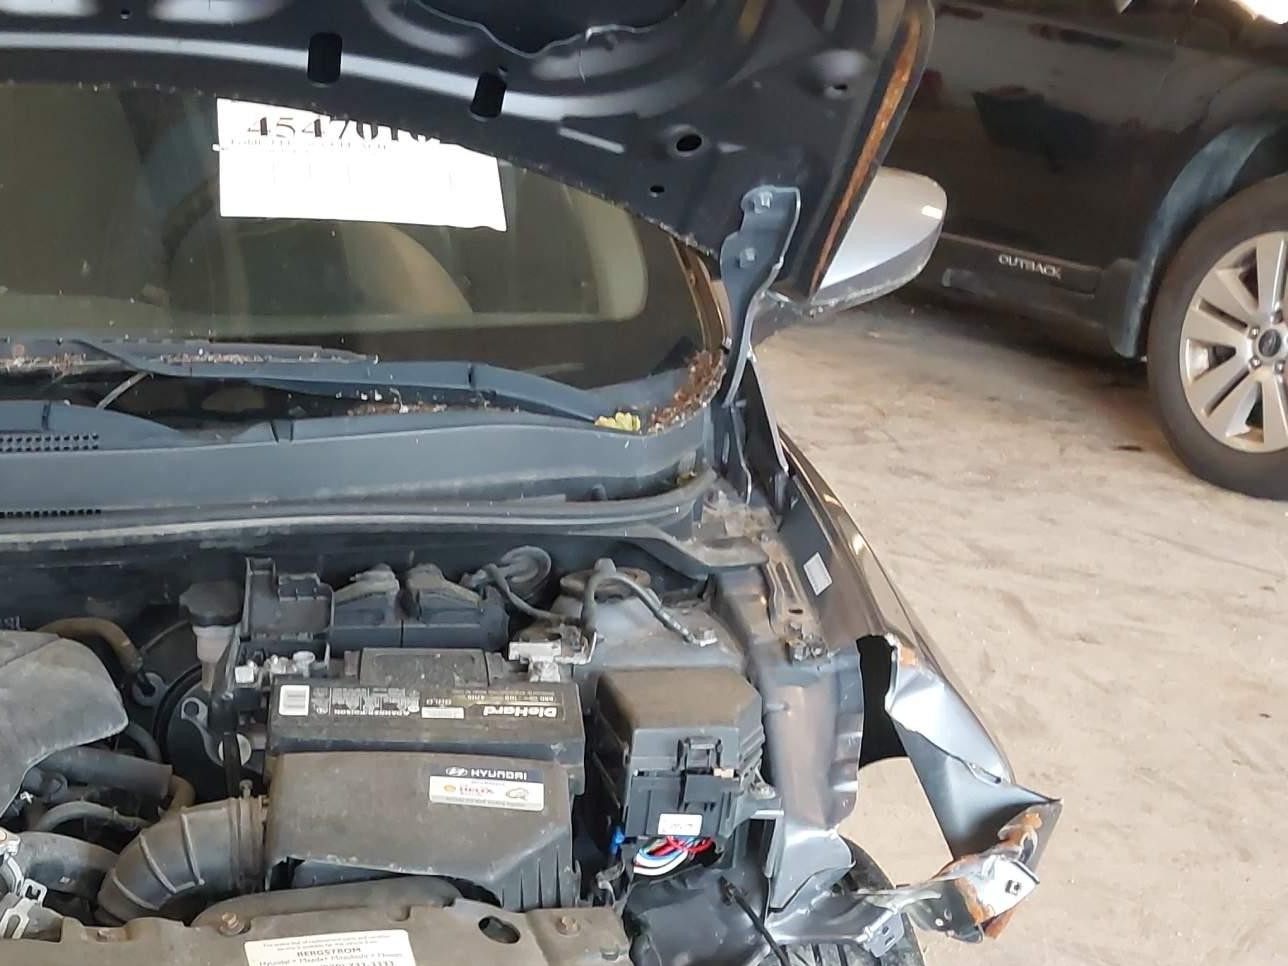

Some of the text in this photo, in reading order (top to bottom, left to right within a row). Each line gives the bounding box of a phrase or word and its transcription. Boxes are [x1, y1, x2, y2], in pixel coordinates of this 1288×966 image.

[998, 254, 1062, 279] OUTBACK
[483, 705, 558, 718] DieHard
[471, 768, 527, 780] HYUNDAI
